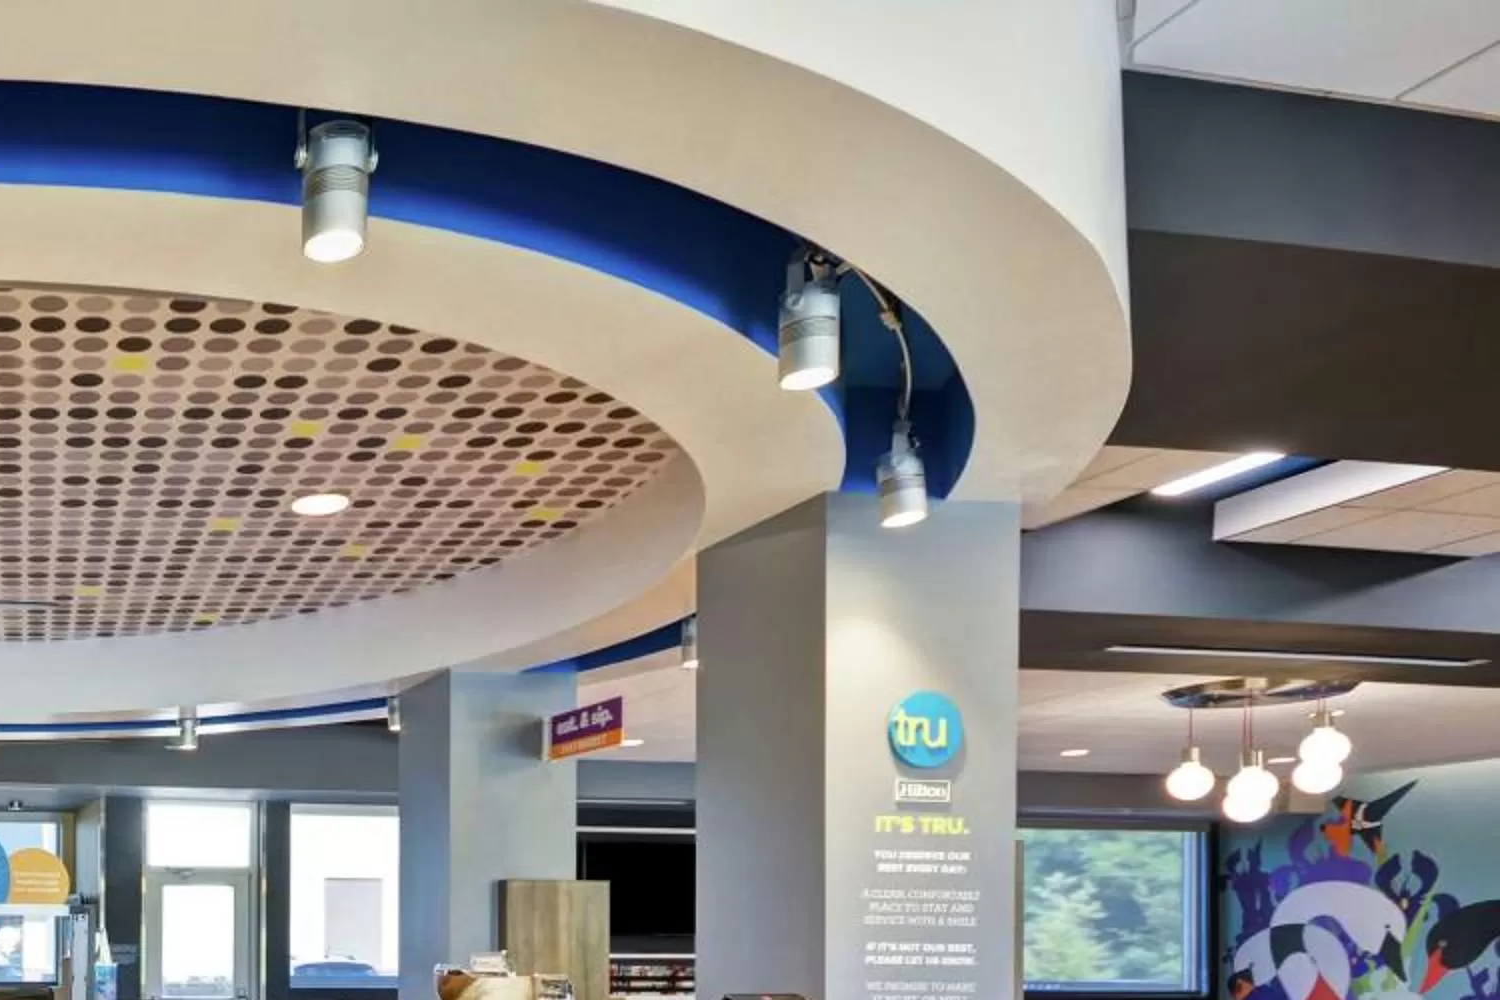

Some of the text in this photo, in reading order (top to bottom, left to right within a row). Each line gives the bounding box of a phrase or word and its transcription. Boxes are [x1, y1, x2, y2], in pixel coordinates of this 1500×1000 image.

[893, 708, 948, 748] tru
[875, 815, 971, 834] IT'S TRU.
